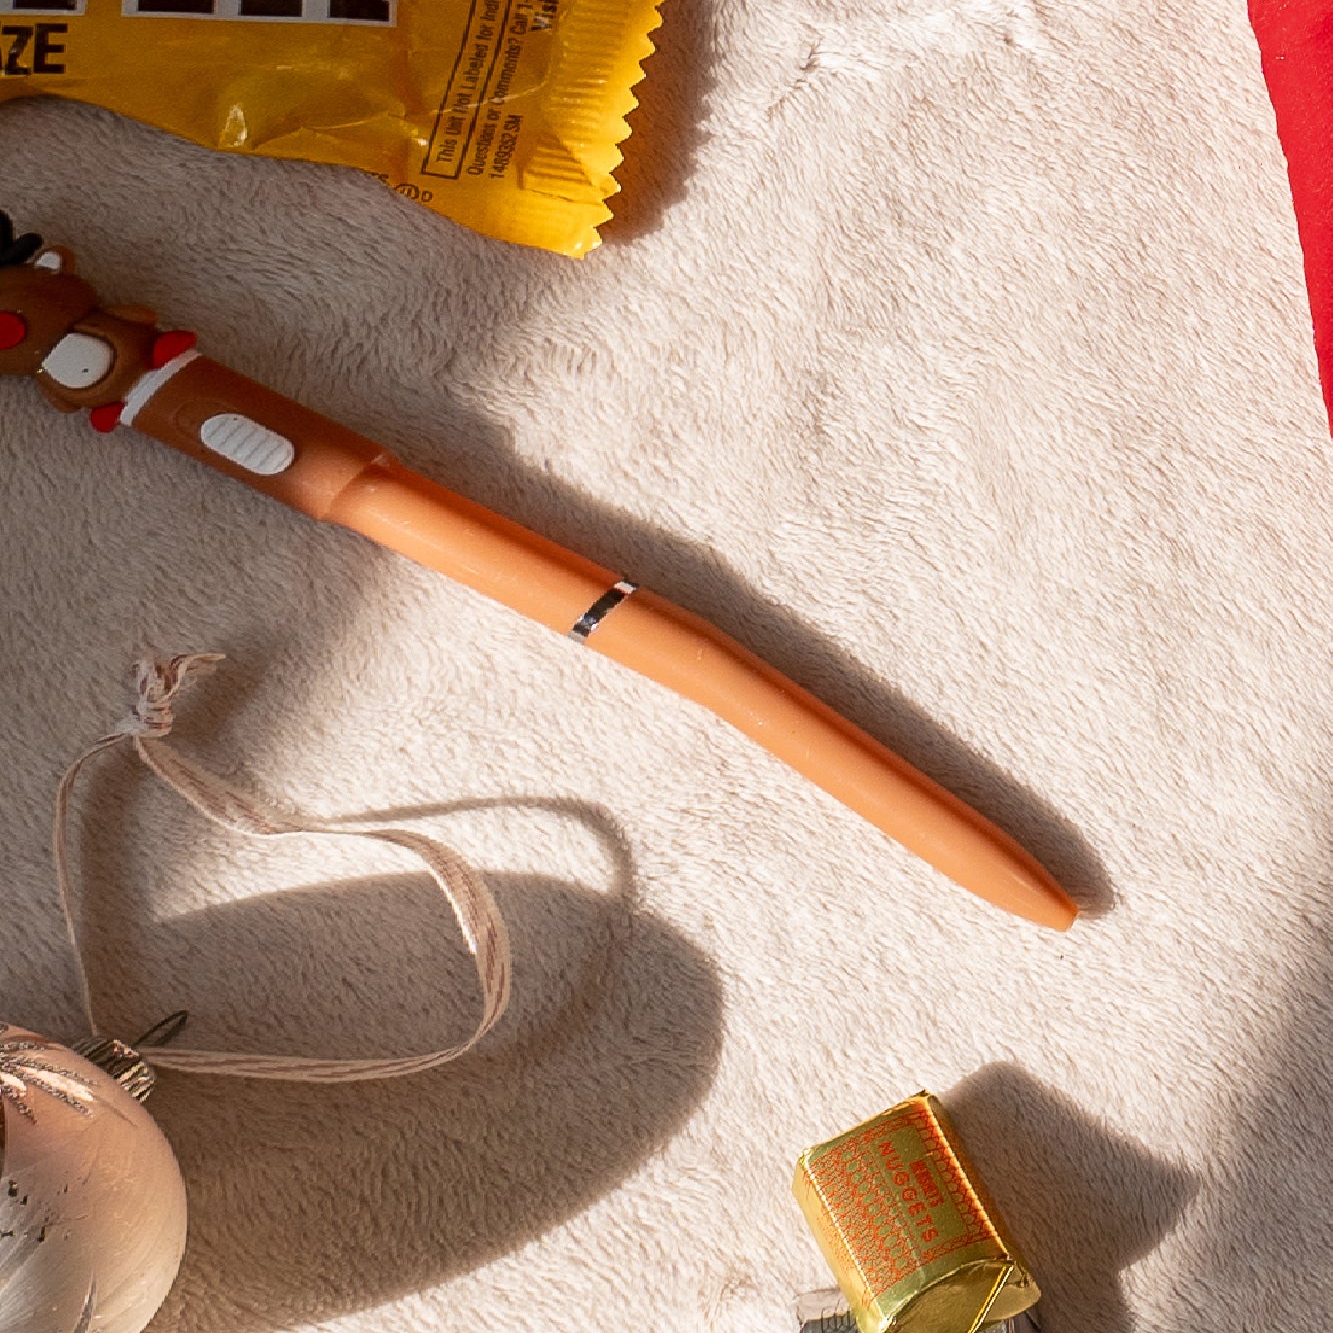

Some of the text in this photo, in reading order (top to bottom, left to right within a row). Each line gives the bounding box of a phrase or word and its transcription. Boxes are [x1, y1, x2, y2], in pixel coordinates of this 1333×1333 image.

[0, 22, 68, 76] ZE
[436, 138, 458, 163] This
[463, 43, 489, 90] Labeled
[480, 23, 495, 41] for
[466, 123, 498, 176] Questions
[487, 109, 501, 123] or
